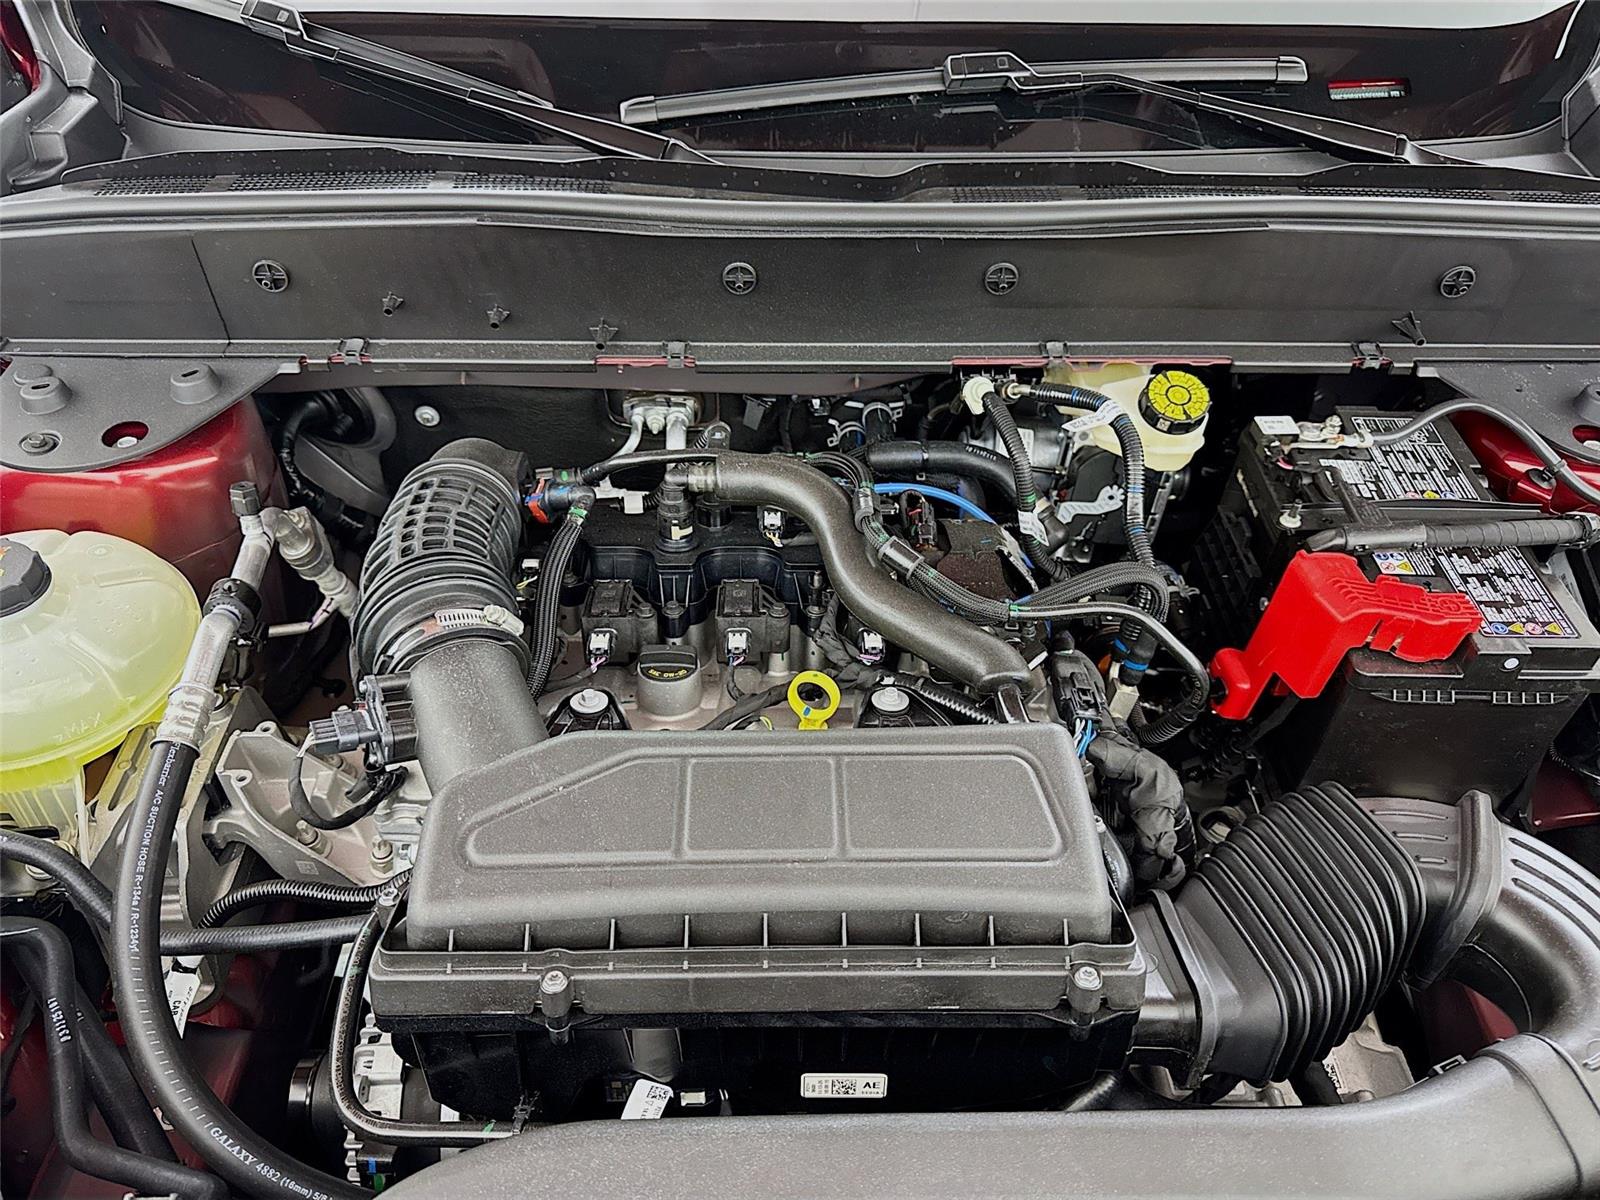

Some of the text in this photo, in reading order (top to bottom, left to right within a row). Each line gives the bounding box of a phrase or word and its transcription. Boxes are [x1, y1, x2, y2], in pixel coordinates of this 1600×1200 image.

[153, 789, 164, 805] A/C
[143, 806, 159, 847] SUCTION
[136, 847, 149, 873] HOSE
[131, 874, 144, 906] R-134a
[210, 1127, 257, 1166] GALAXY
[255, 1162, 281, 1182] 4882
[279, 1176, 313, 1199] (16mm)
